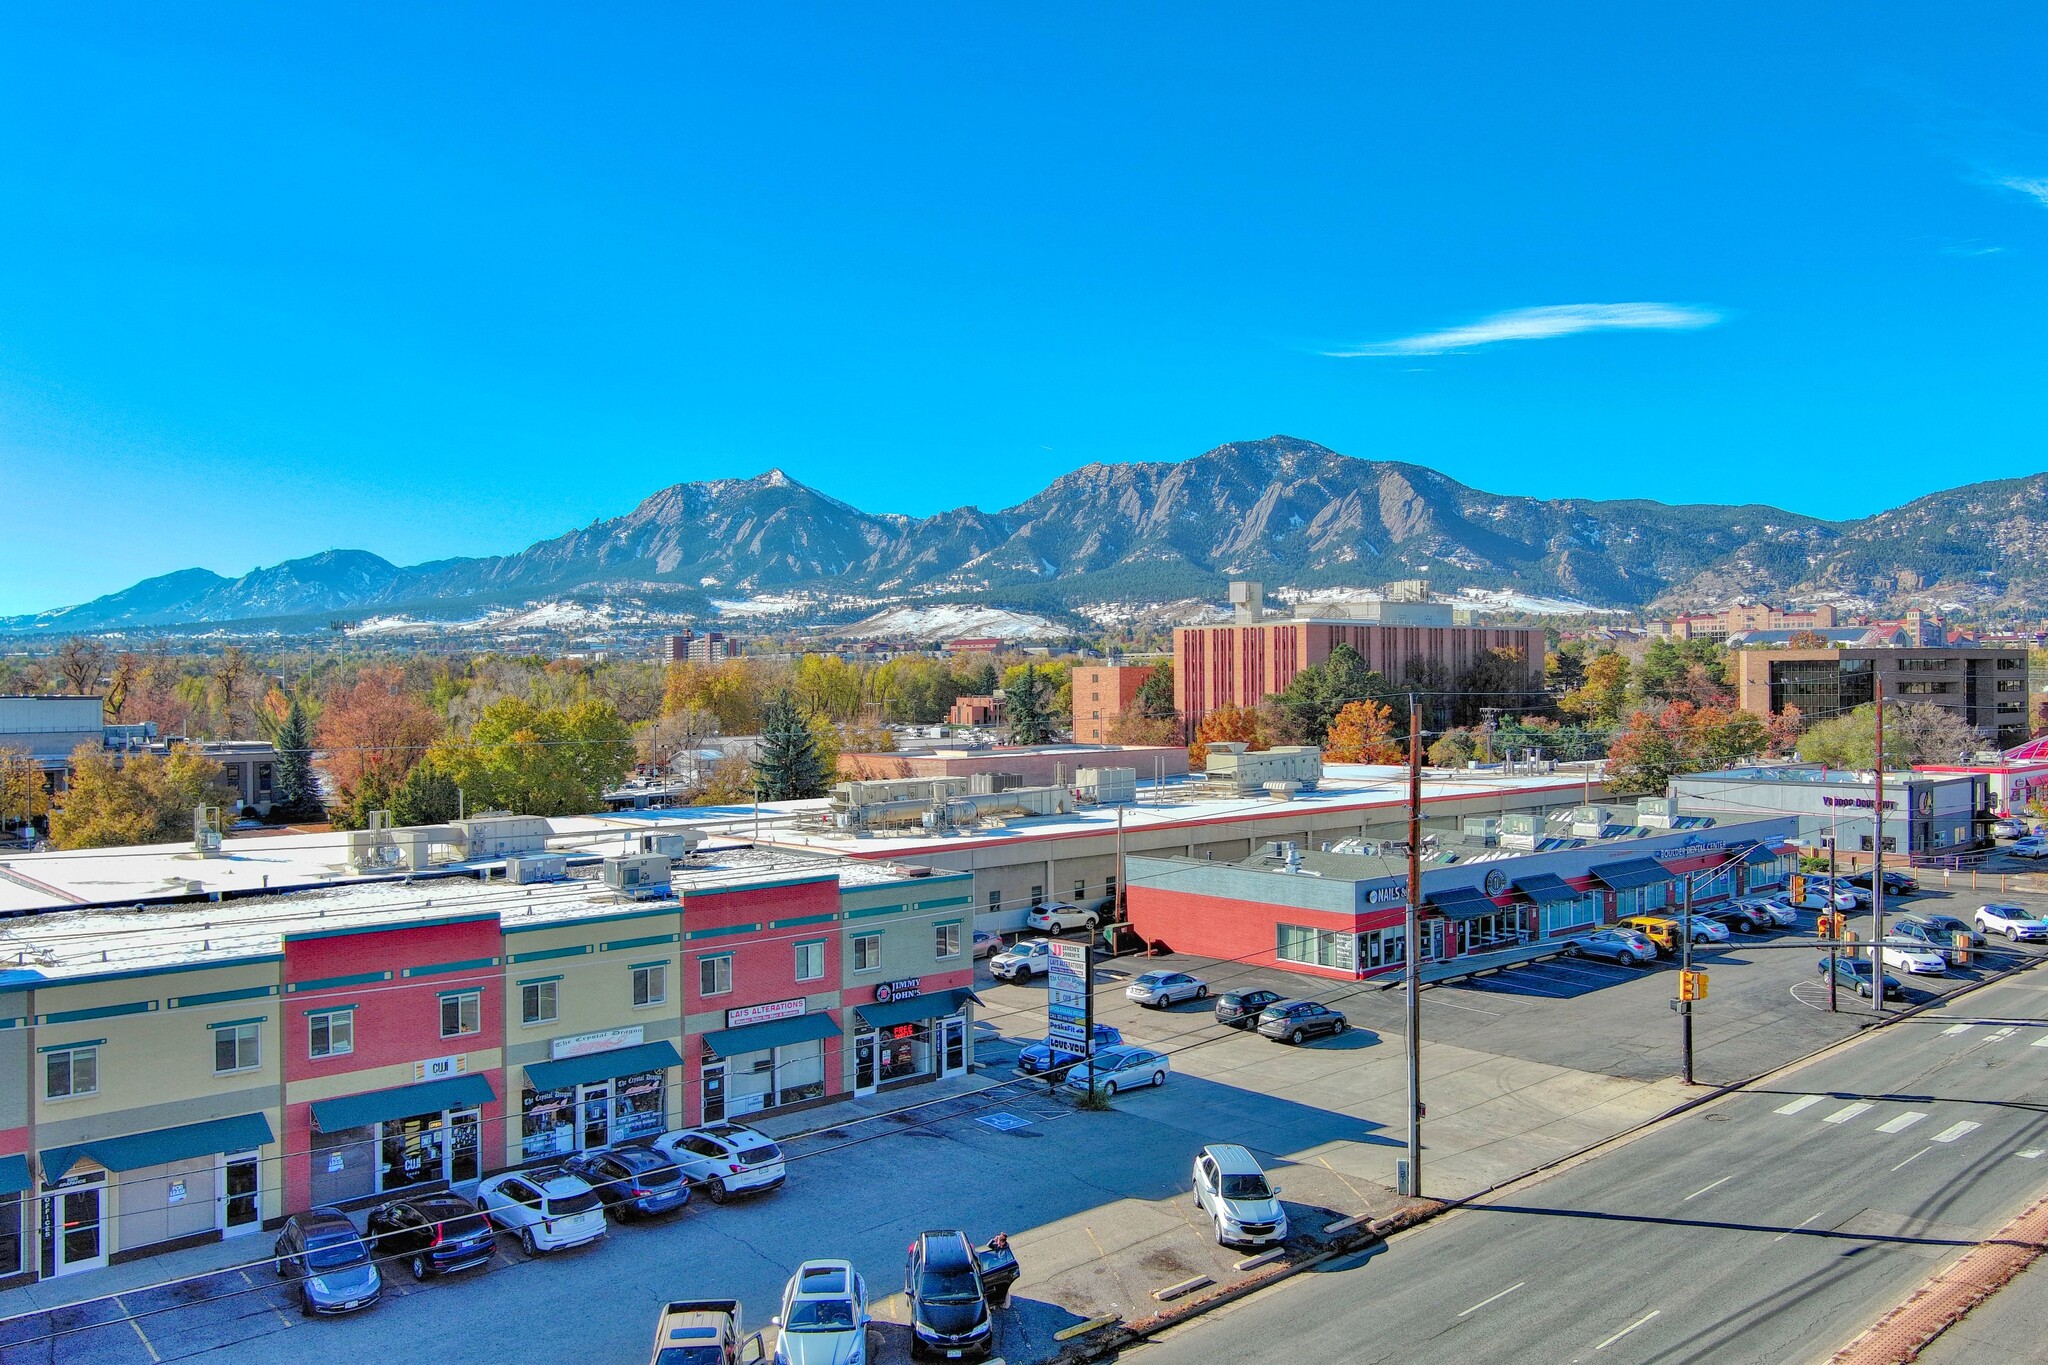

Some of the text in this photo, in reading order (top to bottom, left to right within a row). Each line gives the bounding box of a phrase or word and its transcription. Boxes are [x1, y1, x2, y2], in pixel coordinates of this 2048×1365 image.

[1822, 796, 1895, 810] VOODOO DOUGNUT
[1660, 840, 1727, 859] BOULDER DENTAL CENTER
[1378, 886, 1400, 902] NAILS
[1060, 960, 1085, 970] ALTERATIONS
[892, 979, 921, 992] JIMMY
[892, 989, 921, 1002] JOHN'S
[752, 1000, 804, 1015] ALTERATIONS
[893, 1024, 913, 1035] FREE
[1050, 1022, 1076, 1032] PeaksFit
[555, 1028, 643, 1048] The Crystal Dragon
[432, 1058, 450, 1074] CUJÍ
[405, 1155, 421, 1170] CUJÍ
